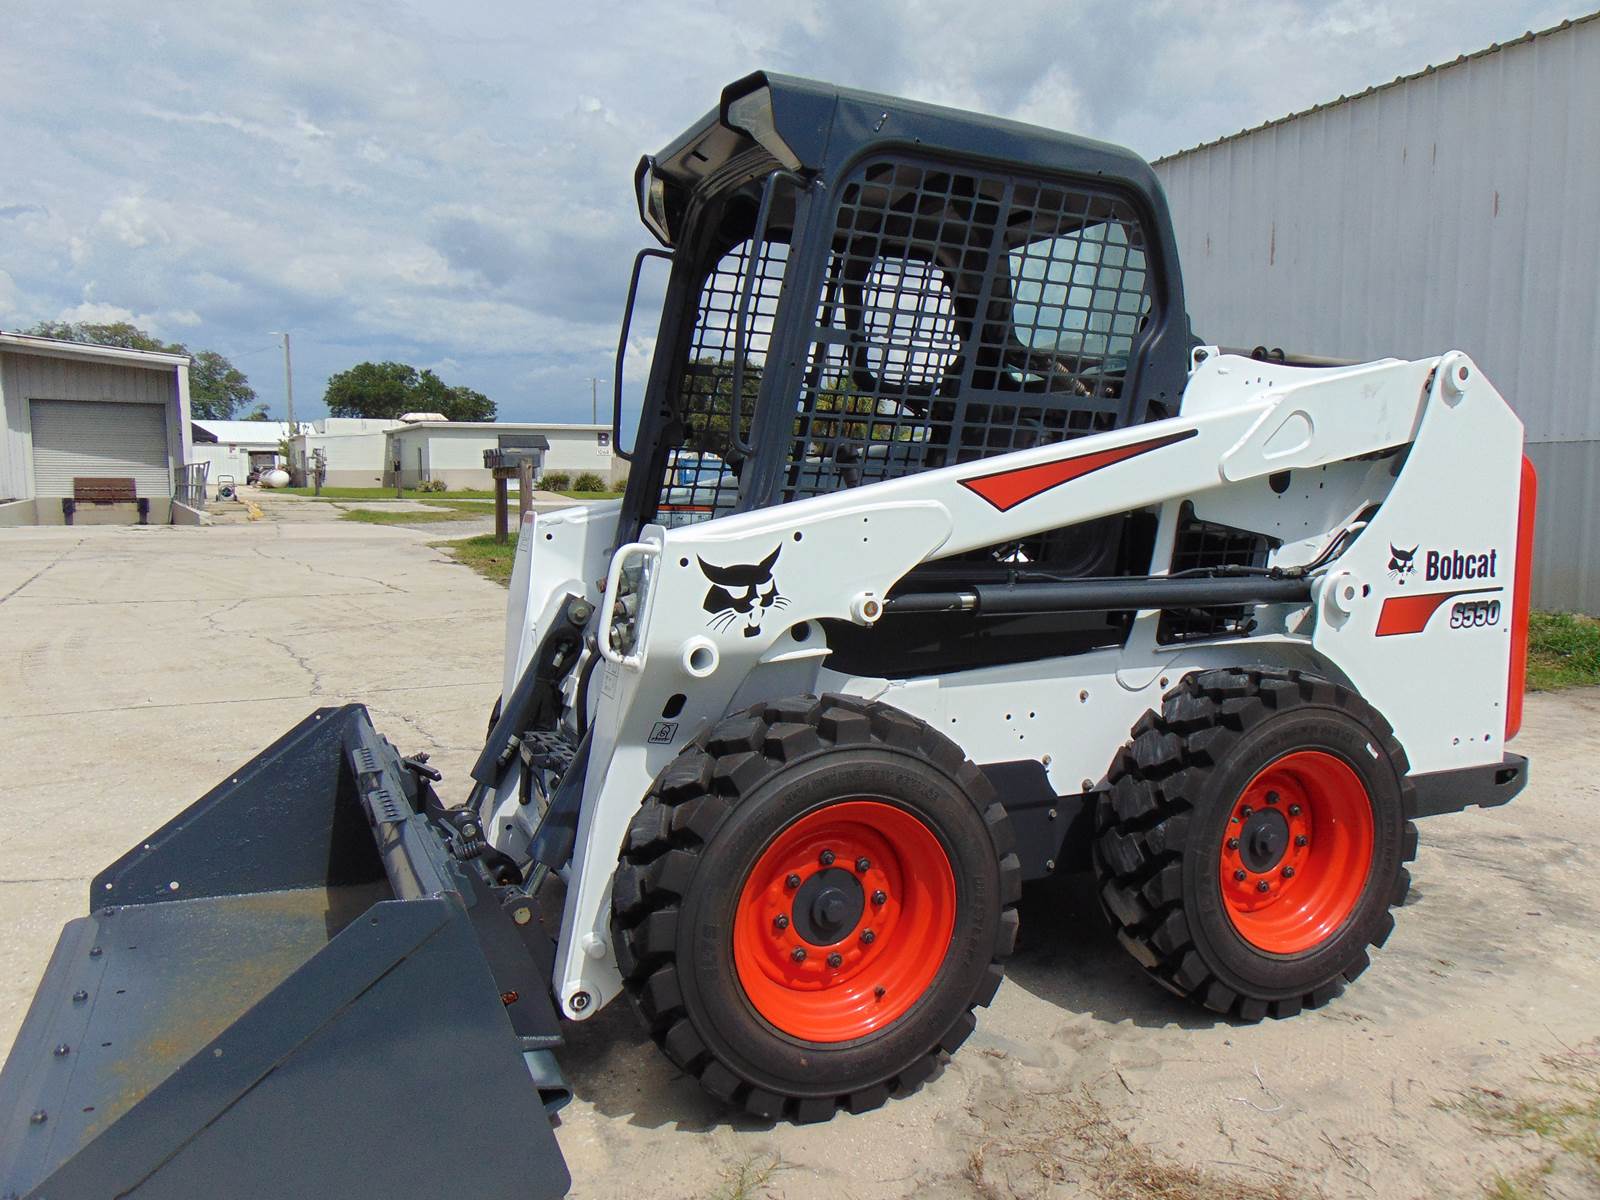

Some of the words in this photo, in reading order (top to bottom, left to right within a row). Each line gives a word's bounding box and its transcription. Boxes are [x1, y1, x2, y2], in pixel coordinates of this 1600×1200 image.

[598, 432, 609, 446] B
[1425, 549, 1497, 581] Bobcat
[1450, 600, 1501, 629] S550
